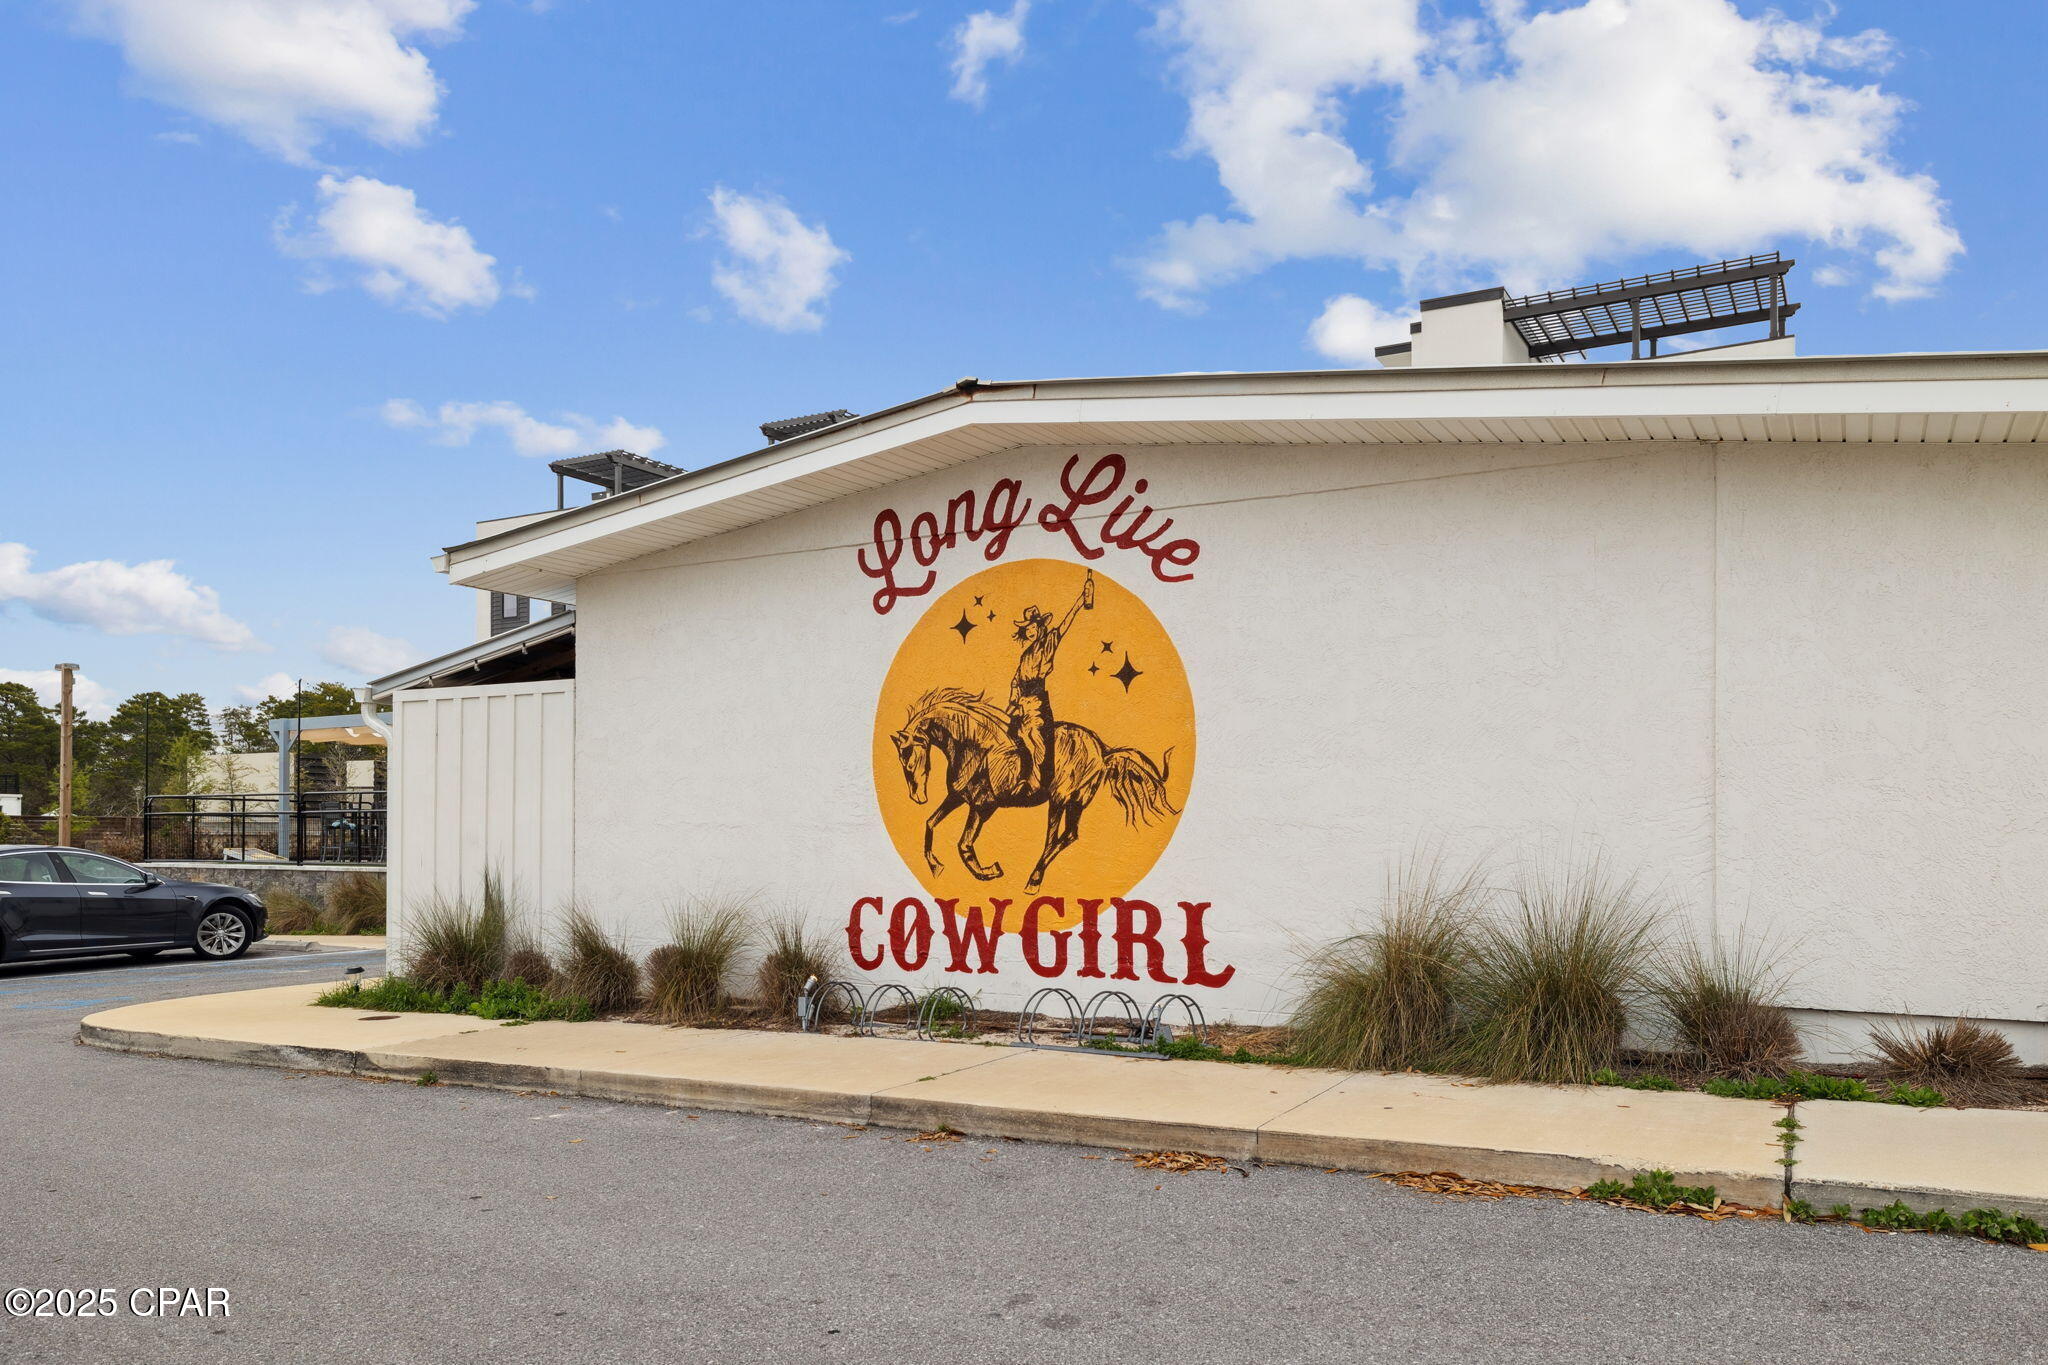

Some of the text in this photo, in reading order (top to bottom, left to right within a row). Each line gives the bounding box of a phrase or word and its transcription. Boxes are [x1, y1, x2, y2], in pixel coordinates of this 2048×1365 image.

[858, 454, 1200, 614] Long Live
[845, 896, 1235, 988] COWGIRL
